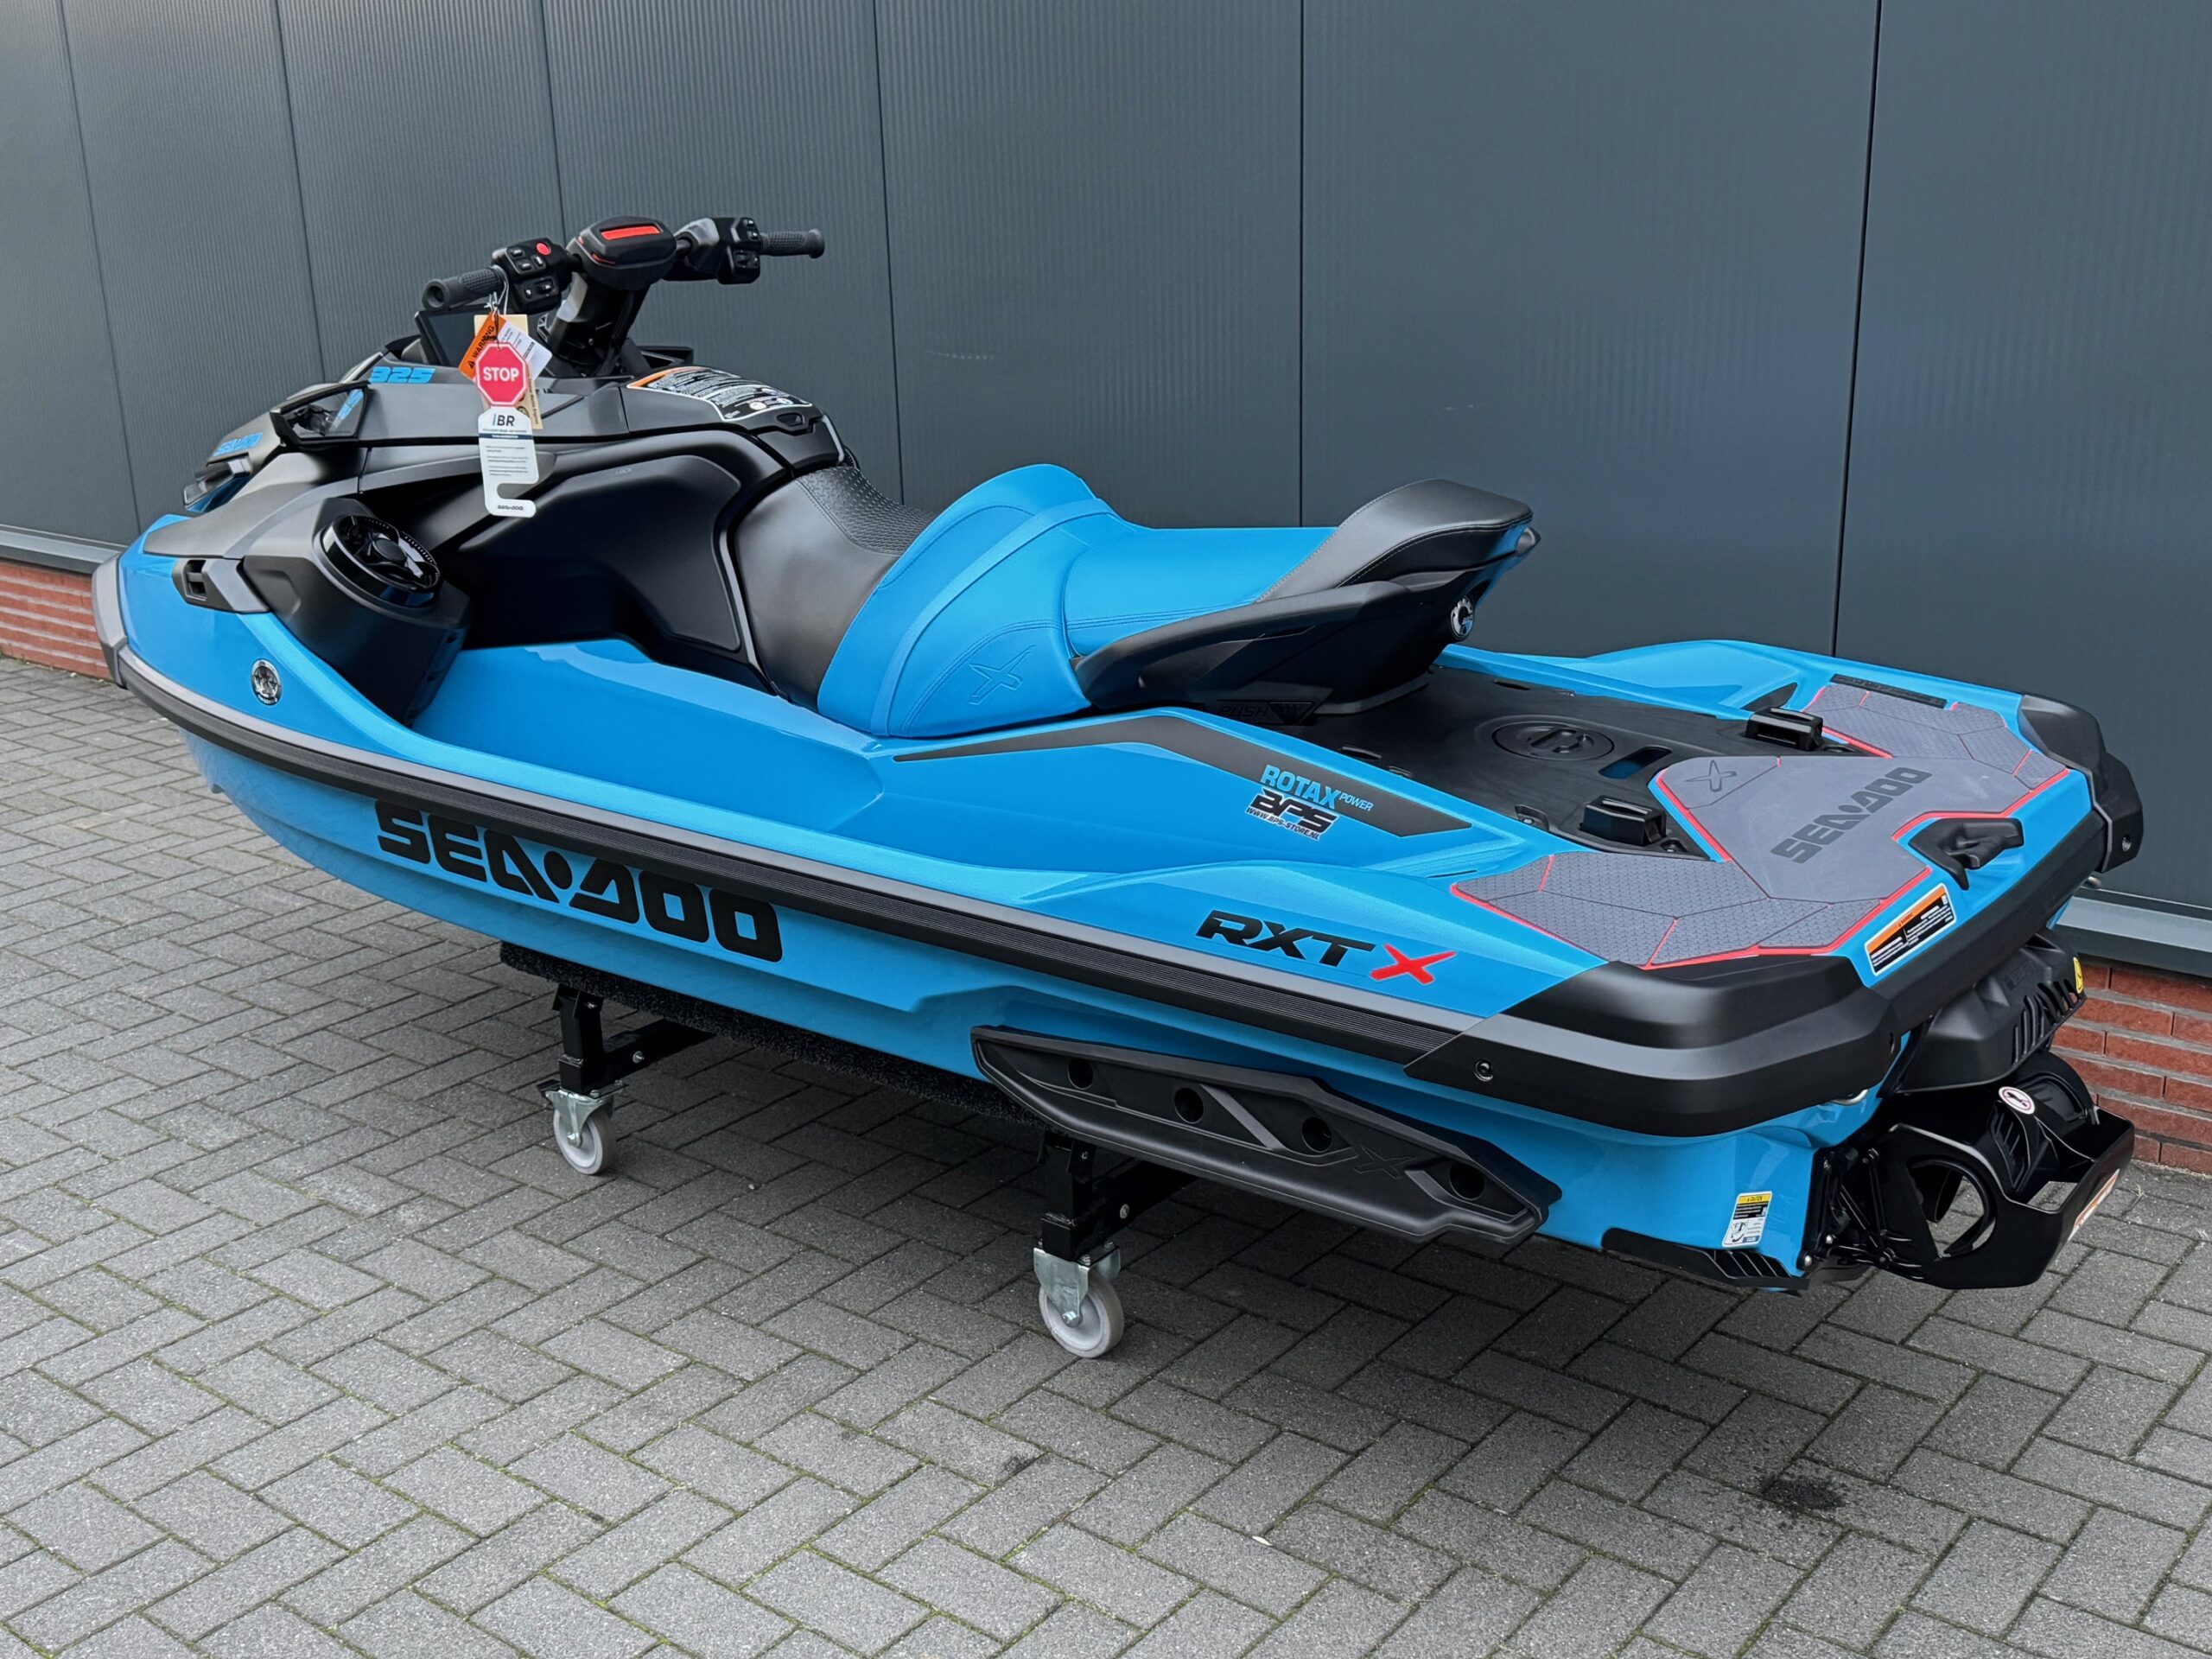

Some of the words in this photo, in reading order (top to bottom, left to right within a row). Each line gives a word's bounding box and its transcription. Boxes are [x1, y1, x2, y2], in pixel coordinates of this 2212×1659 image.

[369, 366, 435, 384] 325
[483, 366, 519, 382] STOP
[1261, 765, 1340, 810] ROTAX
[1339, 792, 1374, 811] POWER
[1196, 910, 1376, 967] RXT
